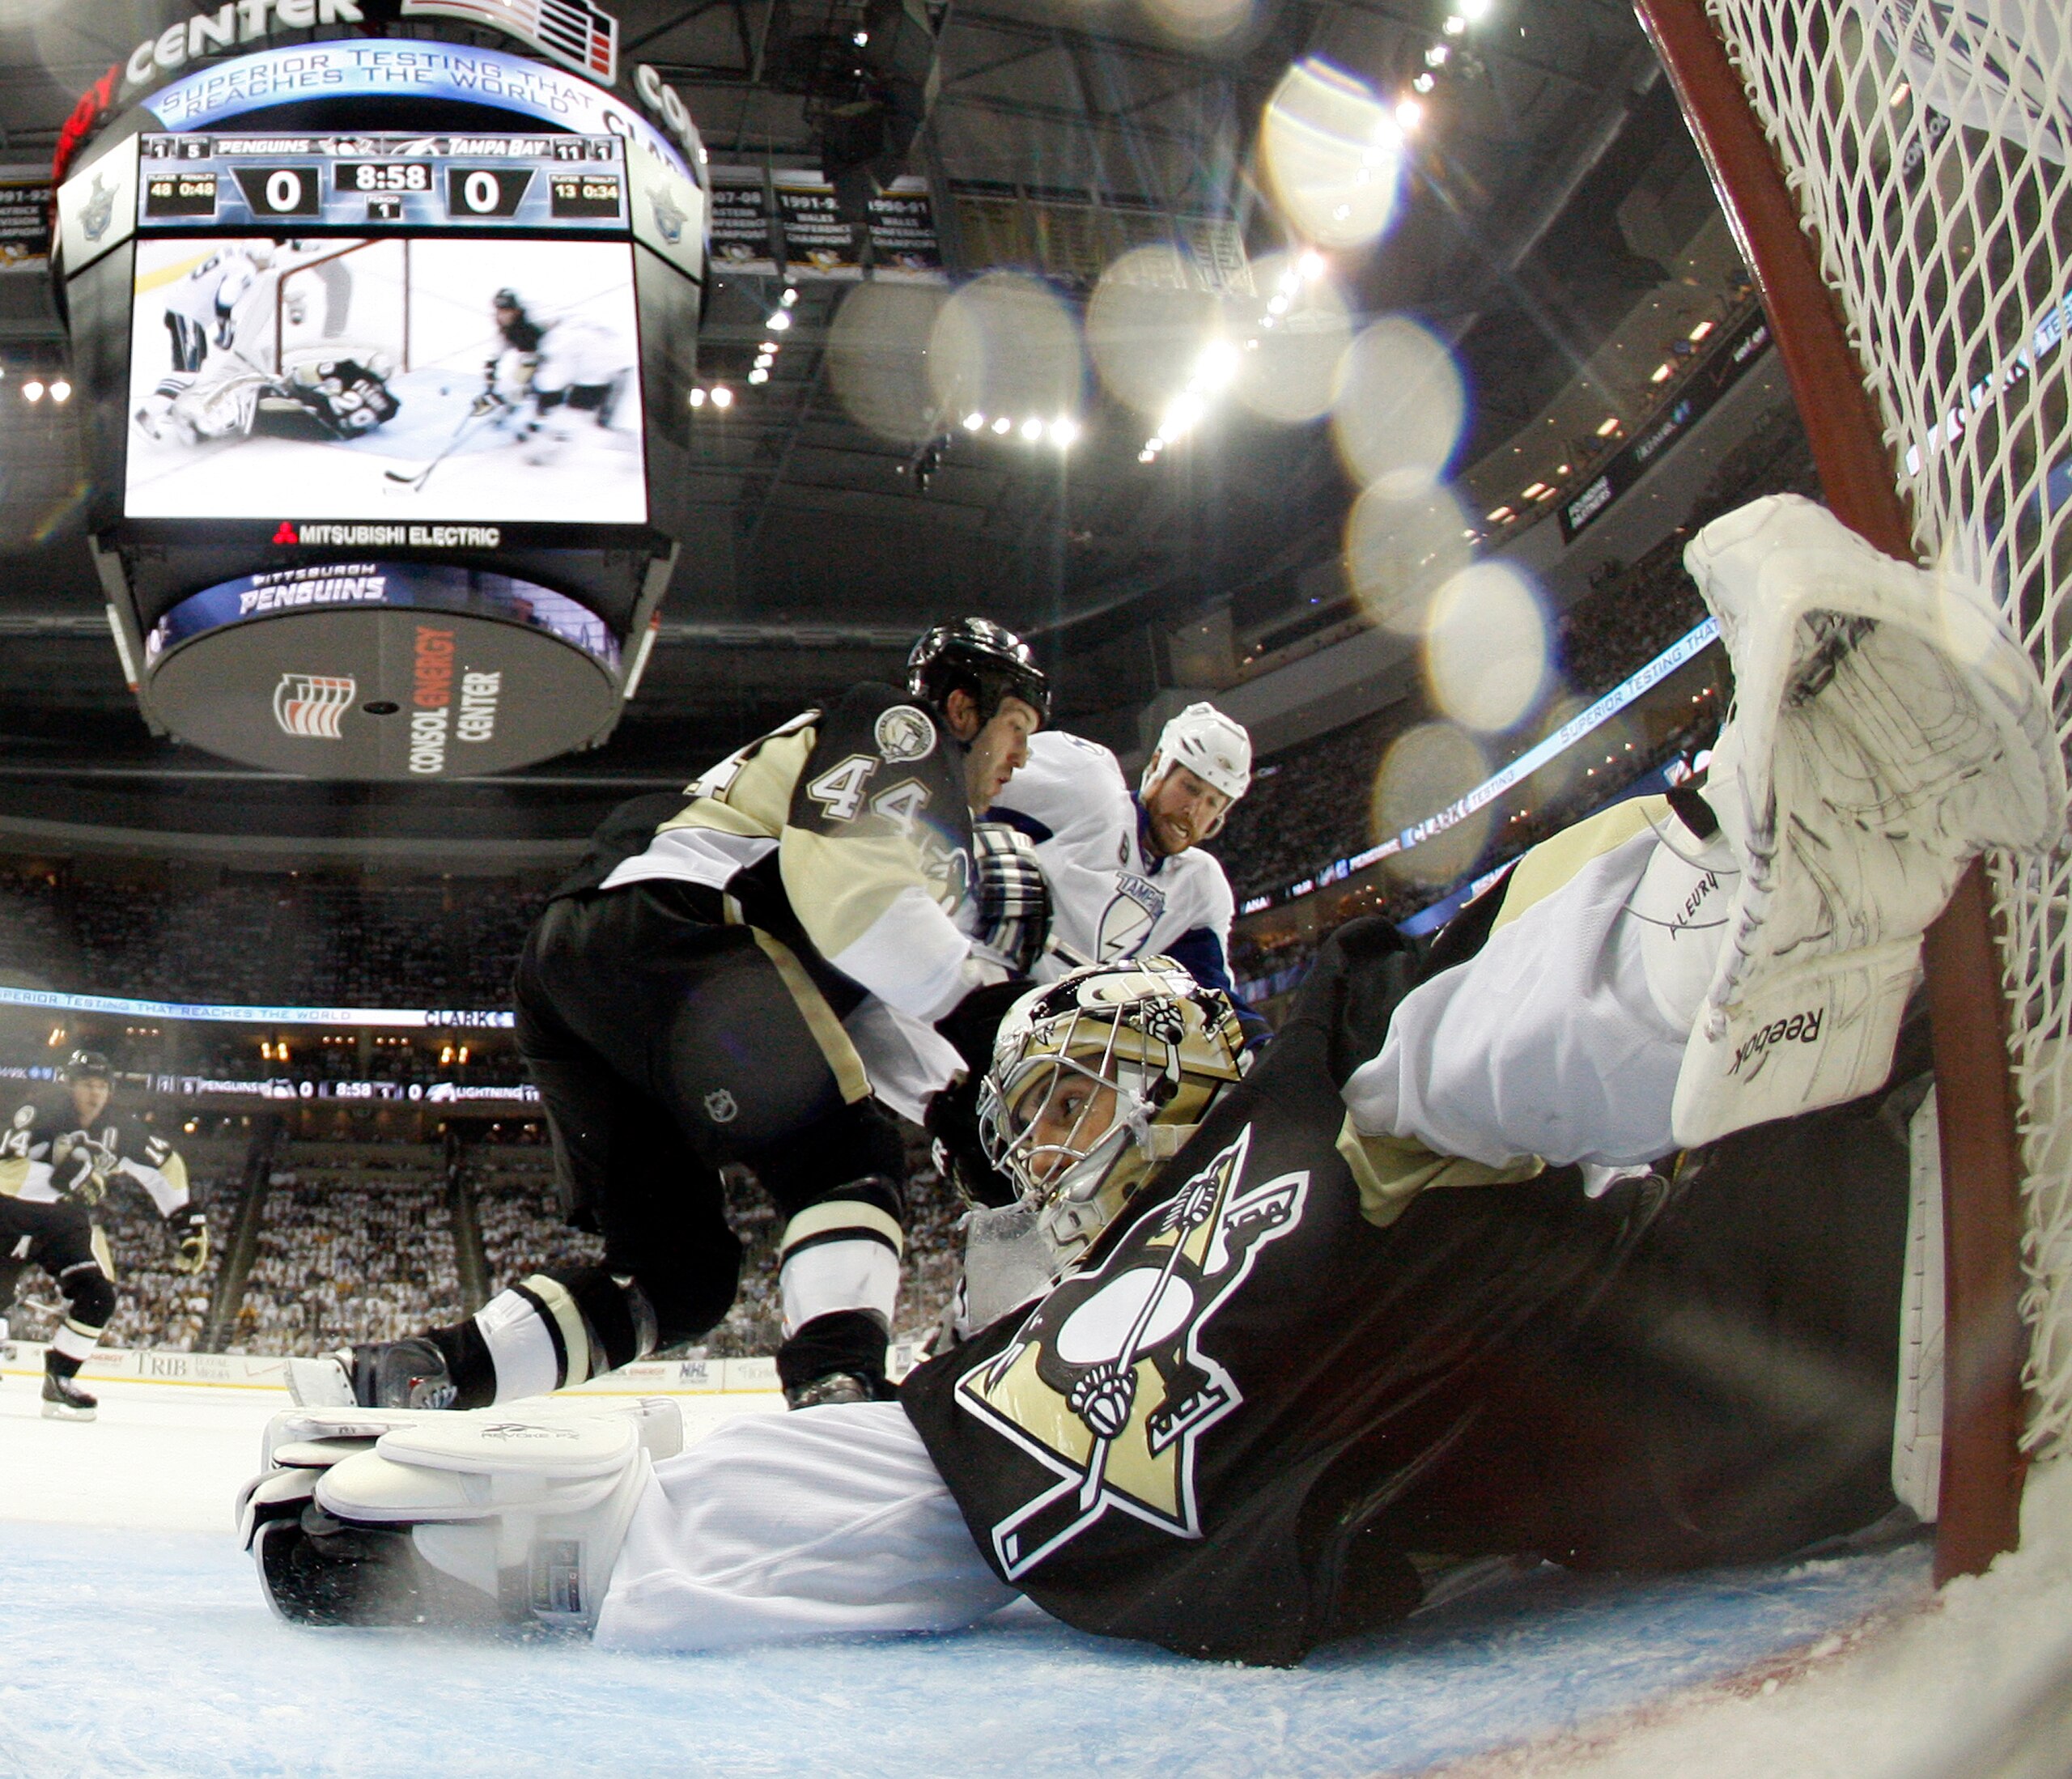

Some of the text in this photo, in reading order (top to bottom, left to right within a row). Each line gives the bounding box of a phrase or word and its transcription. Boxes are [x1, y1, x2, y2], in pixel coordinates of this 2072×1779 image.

[125, 0, 363, 84] CENTER
[163, 49, 594, 113] SUPERIOR TESTING THAT
[185, 66, 569, 119] REACHES THE WORLD
[154, 144, 201, 158] 1 5
[218, 139, 310, 154] PENGUINS
[448, 138, 549, 157] TAMPA BAY
[558, 146, 607, 160] 11 1
[151, 182, 215, 197] 48 0:48
[356, 164, 427, 191] 8:58
[265, 170, 302, 213] 0
[464, 170, 500, 214] 0
[555, 184, 618, 199] 13 0:34
[781, 195, 839, 210] 1991-9
[379, 203, 388, 218] 1
[299, 524, 500, 547] MITSUBISHI ELECTRIC
[253, 563, 376, 585] PITTSBURGH
[239, 576, 388, 614] PENGUINS
[1559, 618, 1720, 743] SUPERIOR TESTING THAT
[409, 626, 456, 774] CONSOL ENERGY
[456, 671, 502, 741] CENTER
[806, 753, 932, 839] 44
[1667, 870, 1719, 941] FLEURY
[0, 987, 352, 1021] PERIOR TESTING THAT REACHES THE WORLD
[1727, 1008, 1824, 1076] Reebok
[299, 1081, 314, 1098] 0
[335, 1081, 372, 1099] 8:58
[407, 1083, 423, 1100] 0
[130, 1351, 187, 1376] TRIB
[680, 1361, 709, 1378] NHL
